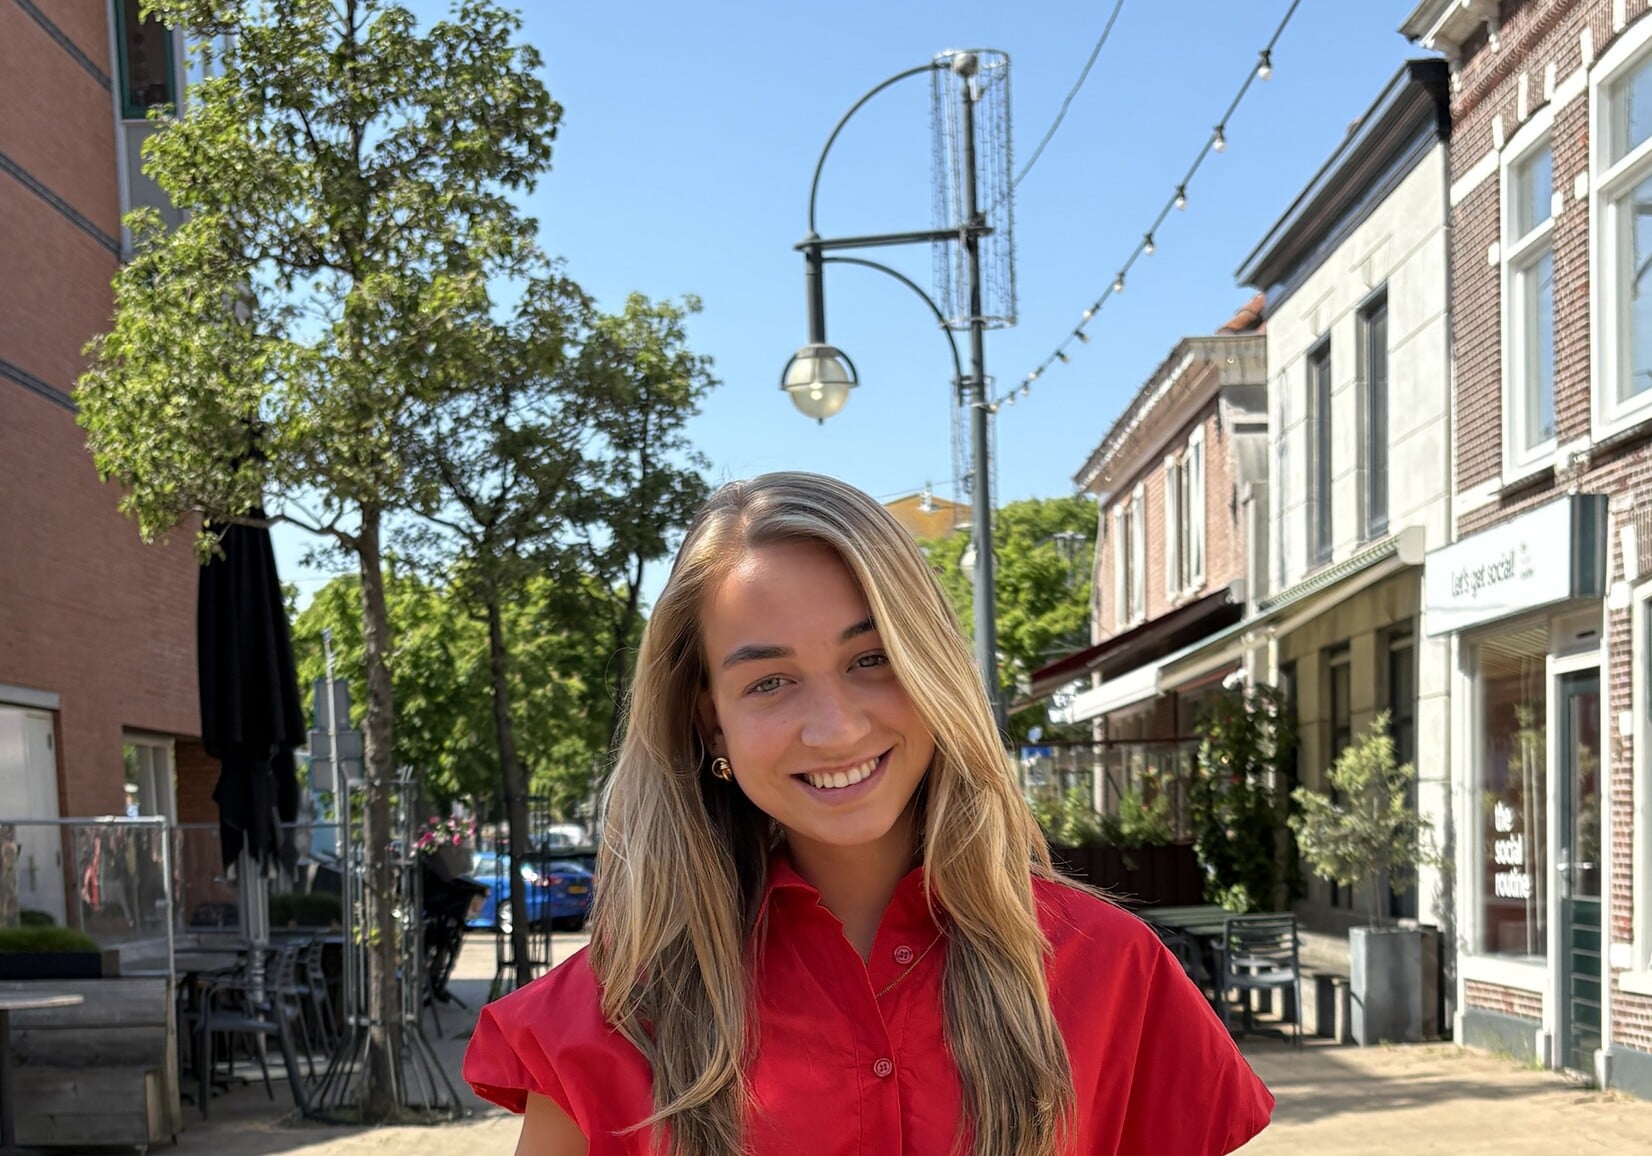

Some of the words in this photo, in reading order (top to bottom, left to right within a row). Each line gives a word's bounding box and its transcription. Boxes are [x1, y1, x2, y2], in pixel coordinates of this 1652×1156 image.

[1471, 563, 1485, 599] get
[1495, 800, 1514, 832] the
[1495, 832, 1522, 865] social
[1495, 867, 1532, 899] routine
